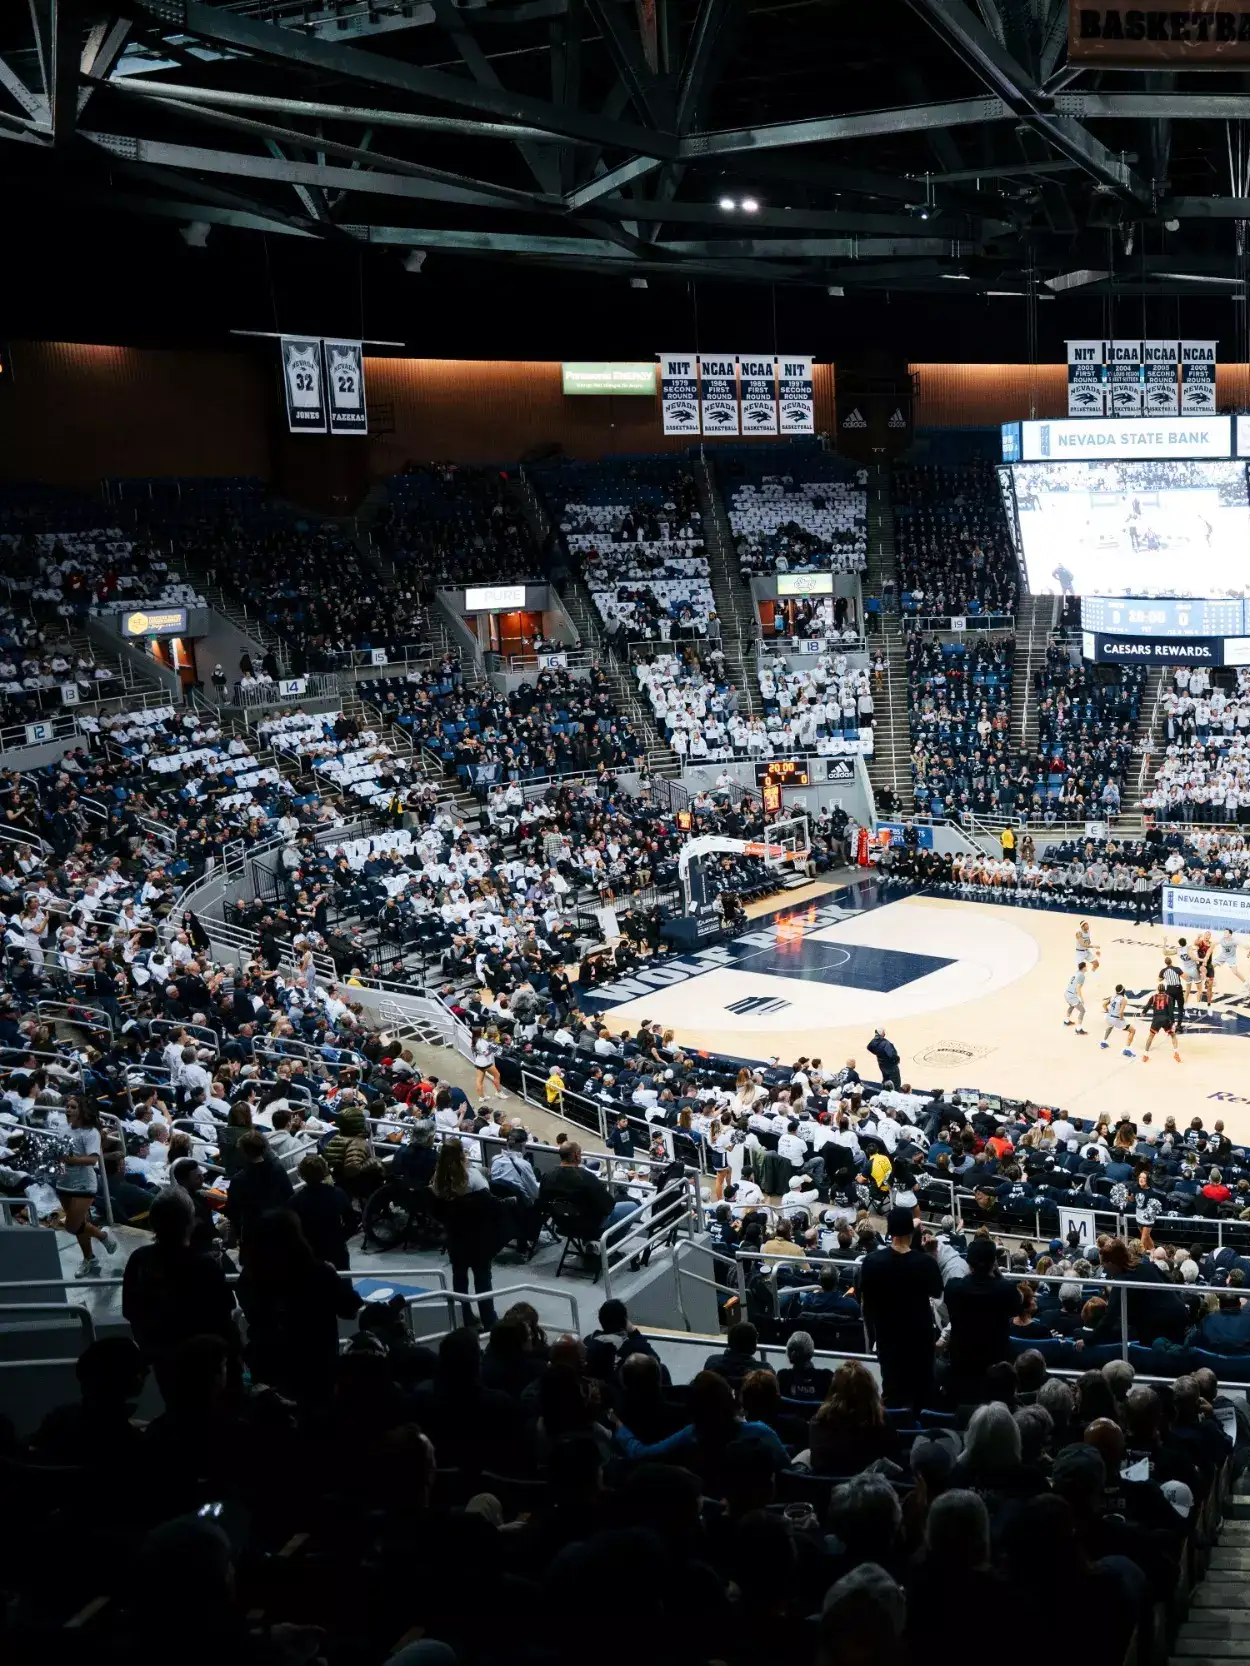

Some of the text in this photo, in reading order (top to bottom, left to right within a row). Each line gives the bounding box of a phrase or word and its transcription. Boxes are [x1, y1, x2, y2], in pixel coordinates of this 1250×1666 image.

[1075, 348, 1095, 360] NIT
[1145, 348, 1176, 360] NCAA
[1183, 348, 1214, 360] NCAA
[668, 362, 690, 374] NIT
[702, 363, 734, 375] NCAA
[742, 363, 773, 375] NCAA
[785, 364, 805, 376] NIT
[297, 374, 313, 391] 32
[338, 377, 355, 392] 22
[1071, 385, 1100, 395] NEVADA
[1147, 385, 1176, 395] NEVADA
[1184, 385, 1213, 395] NEVADA
[666, 402, 697, 412] NEVADA
[704, 402, 736, 413] NEVADA
[744, 403, 774, 413] NEVADA
[782, 402, 811, 412] NEVADA
[296, 411, 320, 420] JONES
[842, 420, 868, 428] adidas
[887, 420, 907, 428] adidas
[1058, 431, 1209, 447] NEVADA STATE BANK
[485, 590, 520, 601] PURE
[954, 620, 963, 628] 19
[806, 641, 819, 651] 18
[1104, 644, 1211, 657] CAESARS REWARDS.
[375, 653, 385, 662] 15
[546, 656, 559, 668] 16
[286, 681, 299, 693] 14
[65, 690, 75, 700] 13
[33, 725, 45, 739] 12
[801, 774, 808, 783] 0
[829, 771, 854, 779] adidas
[765, 777, 771, 785] 0
[1178, 895, 1211, 904] NEVADA
[1214, 899, 1238, 907] STATE
[584, 904, 867, 1001] WOLF PACK
[1068, 1219, 1088, 1237] M
